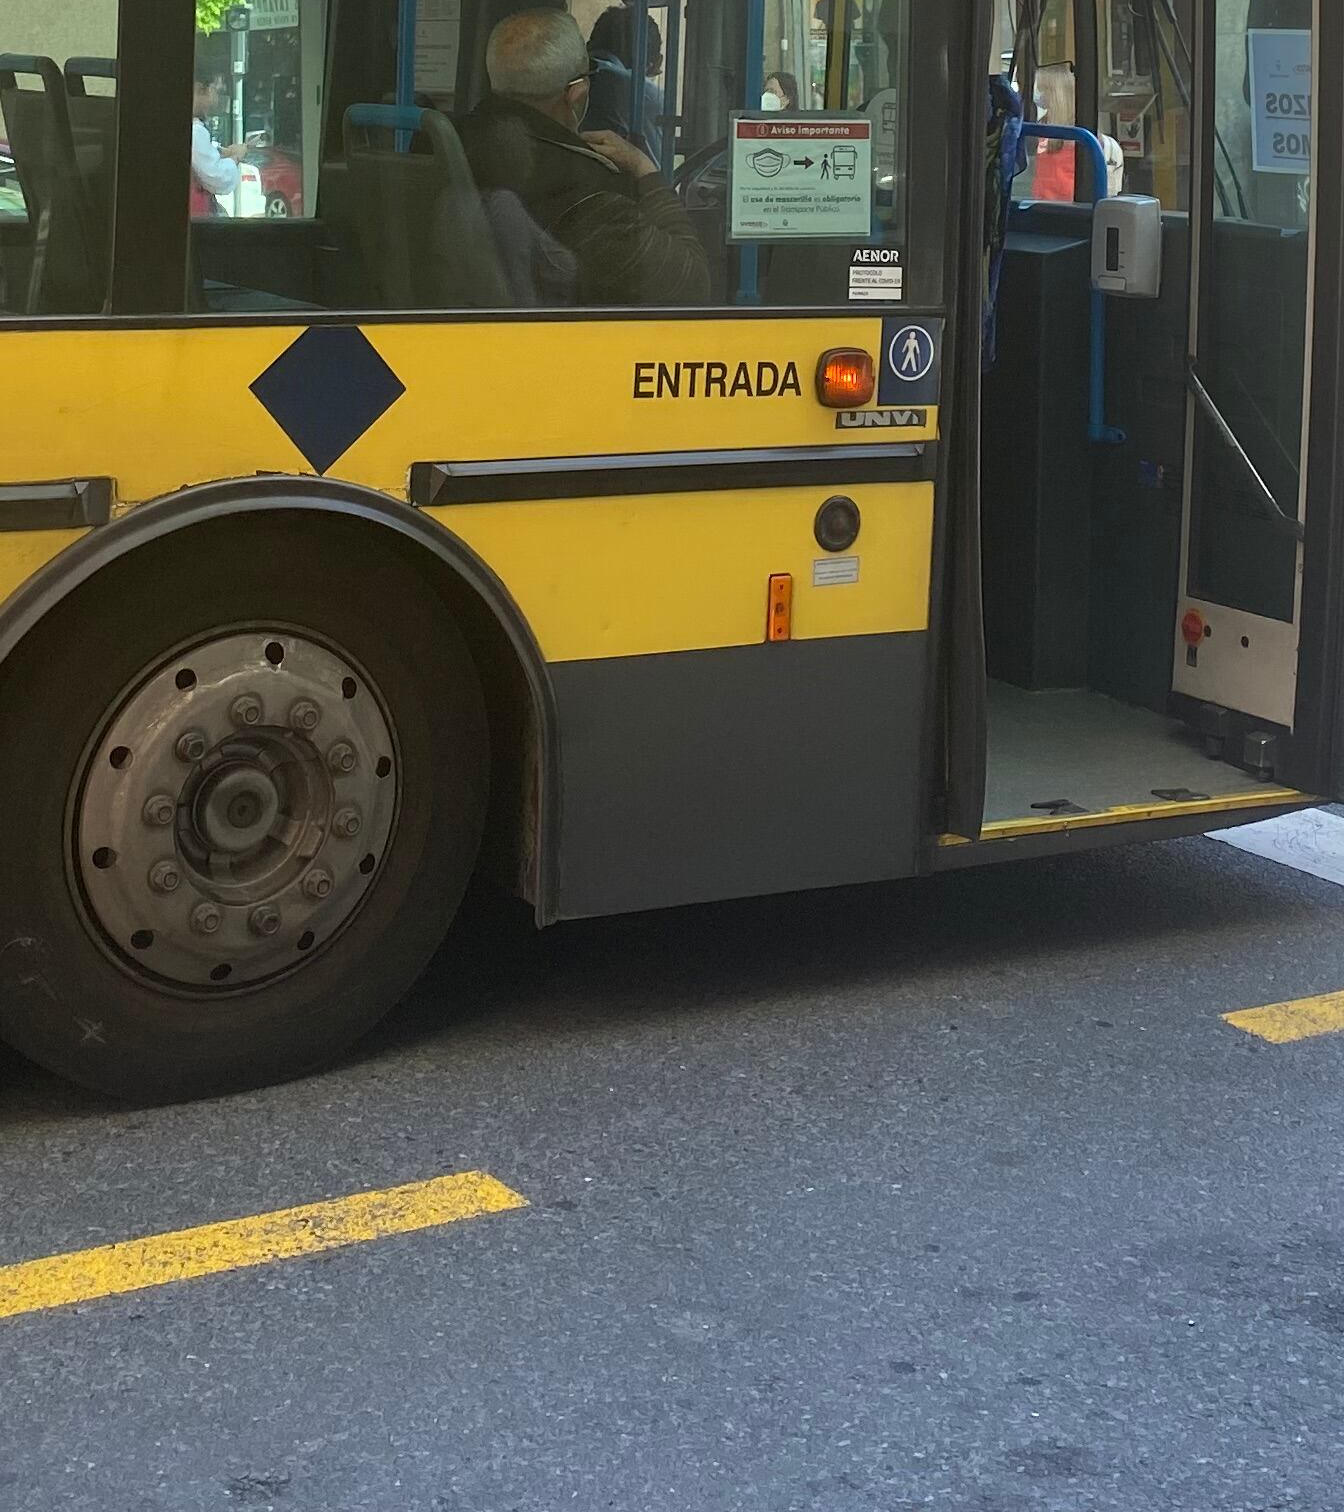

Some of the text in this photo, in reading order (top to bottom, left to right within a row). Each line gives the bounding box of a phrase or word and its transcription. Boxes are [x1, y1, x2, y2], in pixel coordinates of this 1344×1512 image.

[771, 125, 796, 135] Aviso
[852, 249, 899, 263] AENOR
[632, 361, 802, 399] ENTRADA
